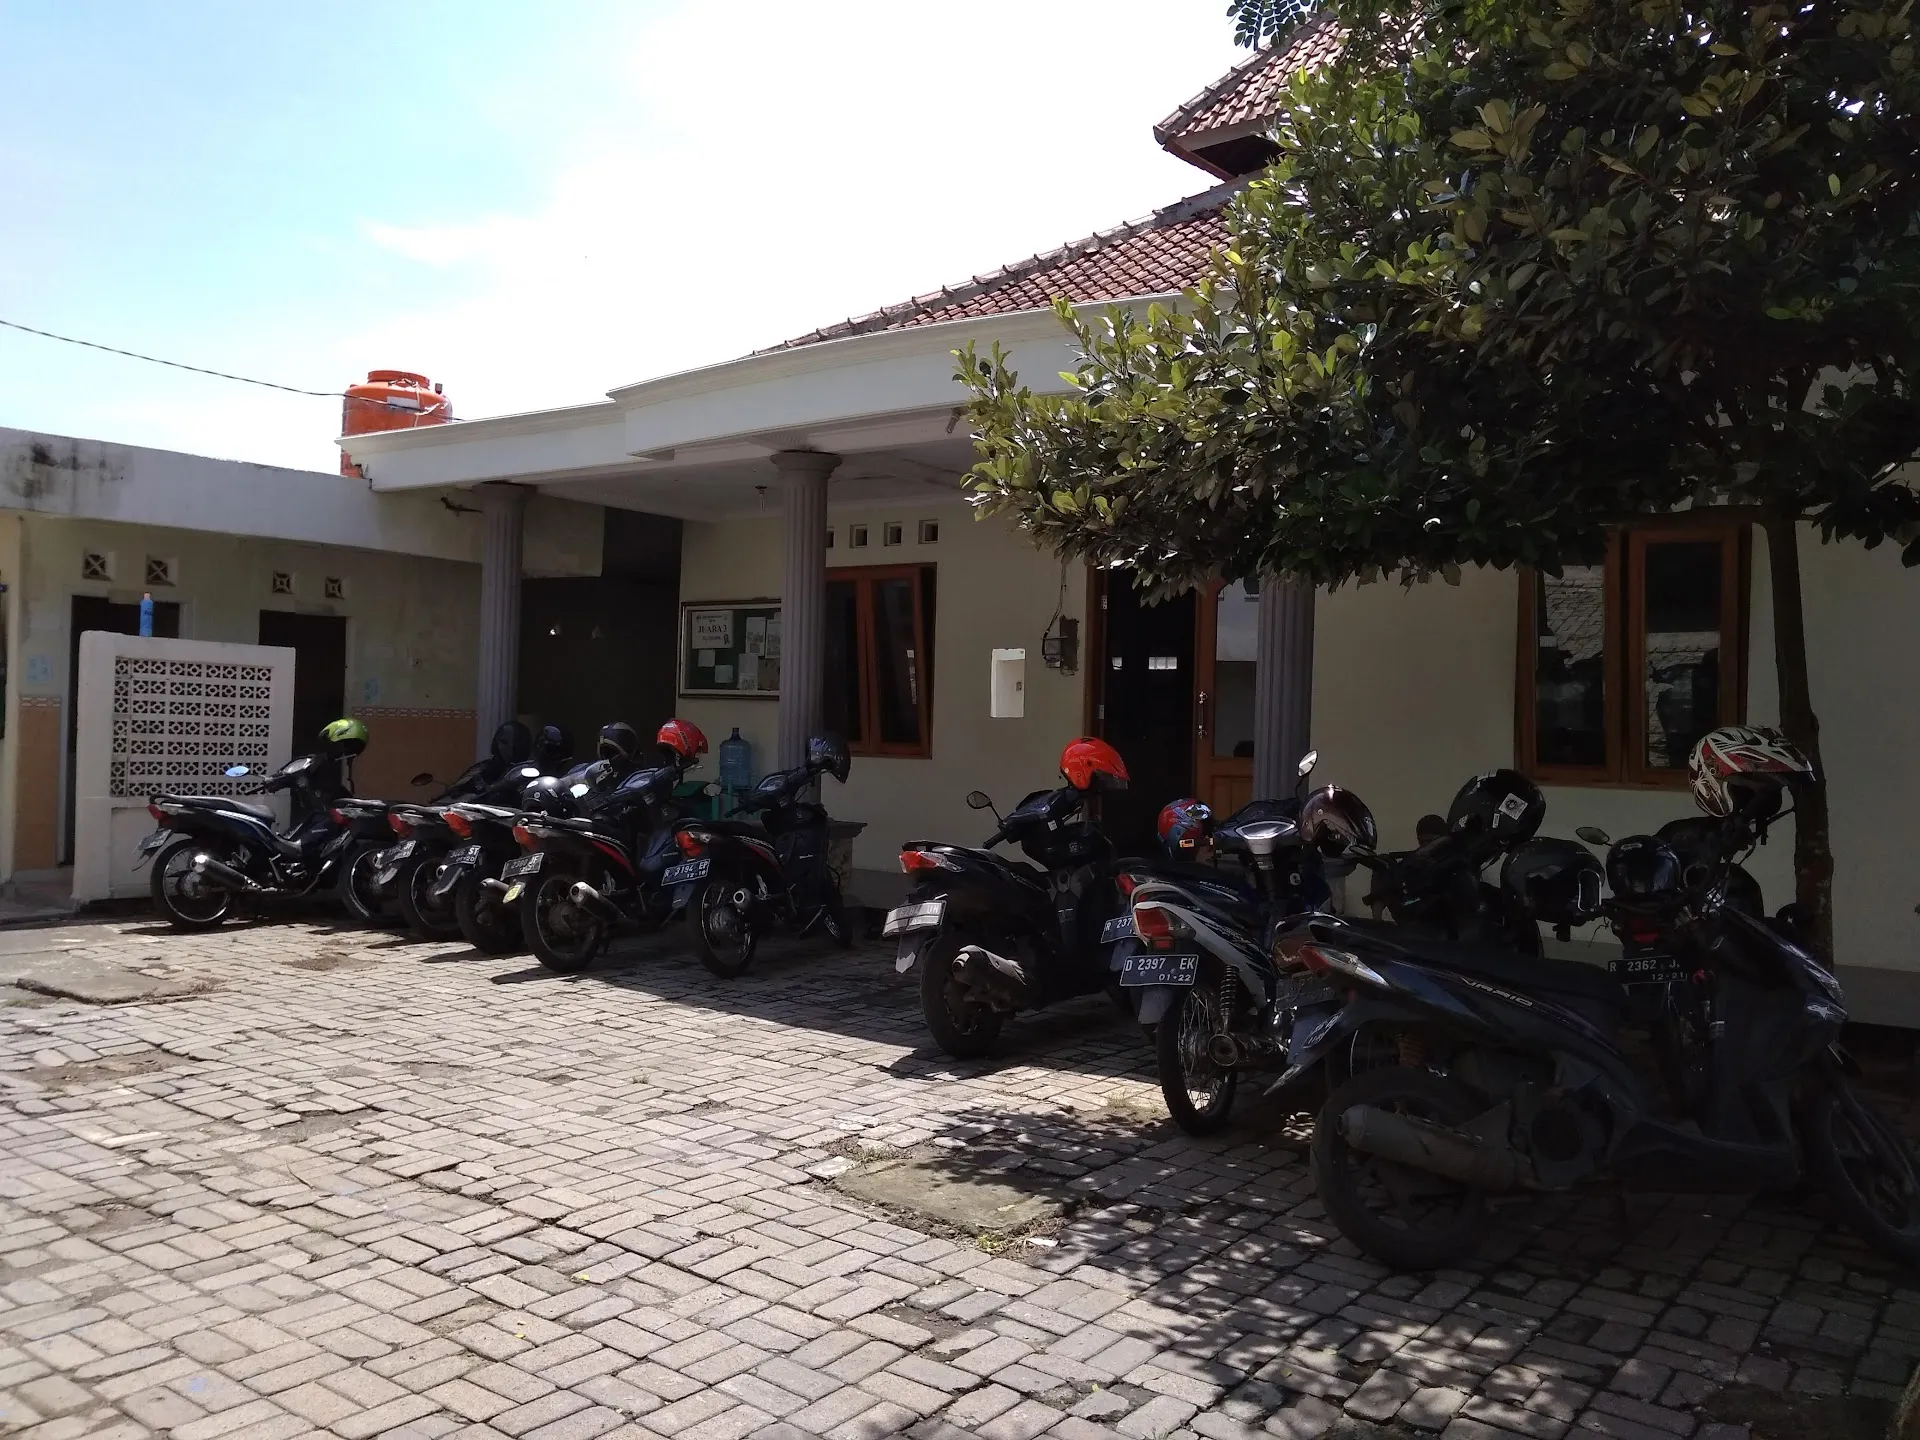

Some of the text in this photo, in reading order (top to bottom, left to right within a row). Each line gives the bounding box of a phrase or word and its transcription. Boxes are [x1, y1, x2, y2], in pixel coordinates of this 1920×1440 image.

[468, 847, 479, 856] ST
[1124, 957, 1196, 972] D 2397 EK
[1609, 961, 1617, 972] R
[1627, 959, 1657, 972] 2362
